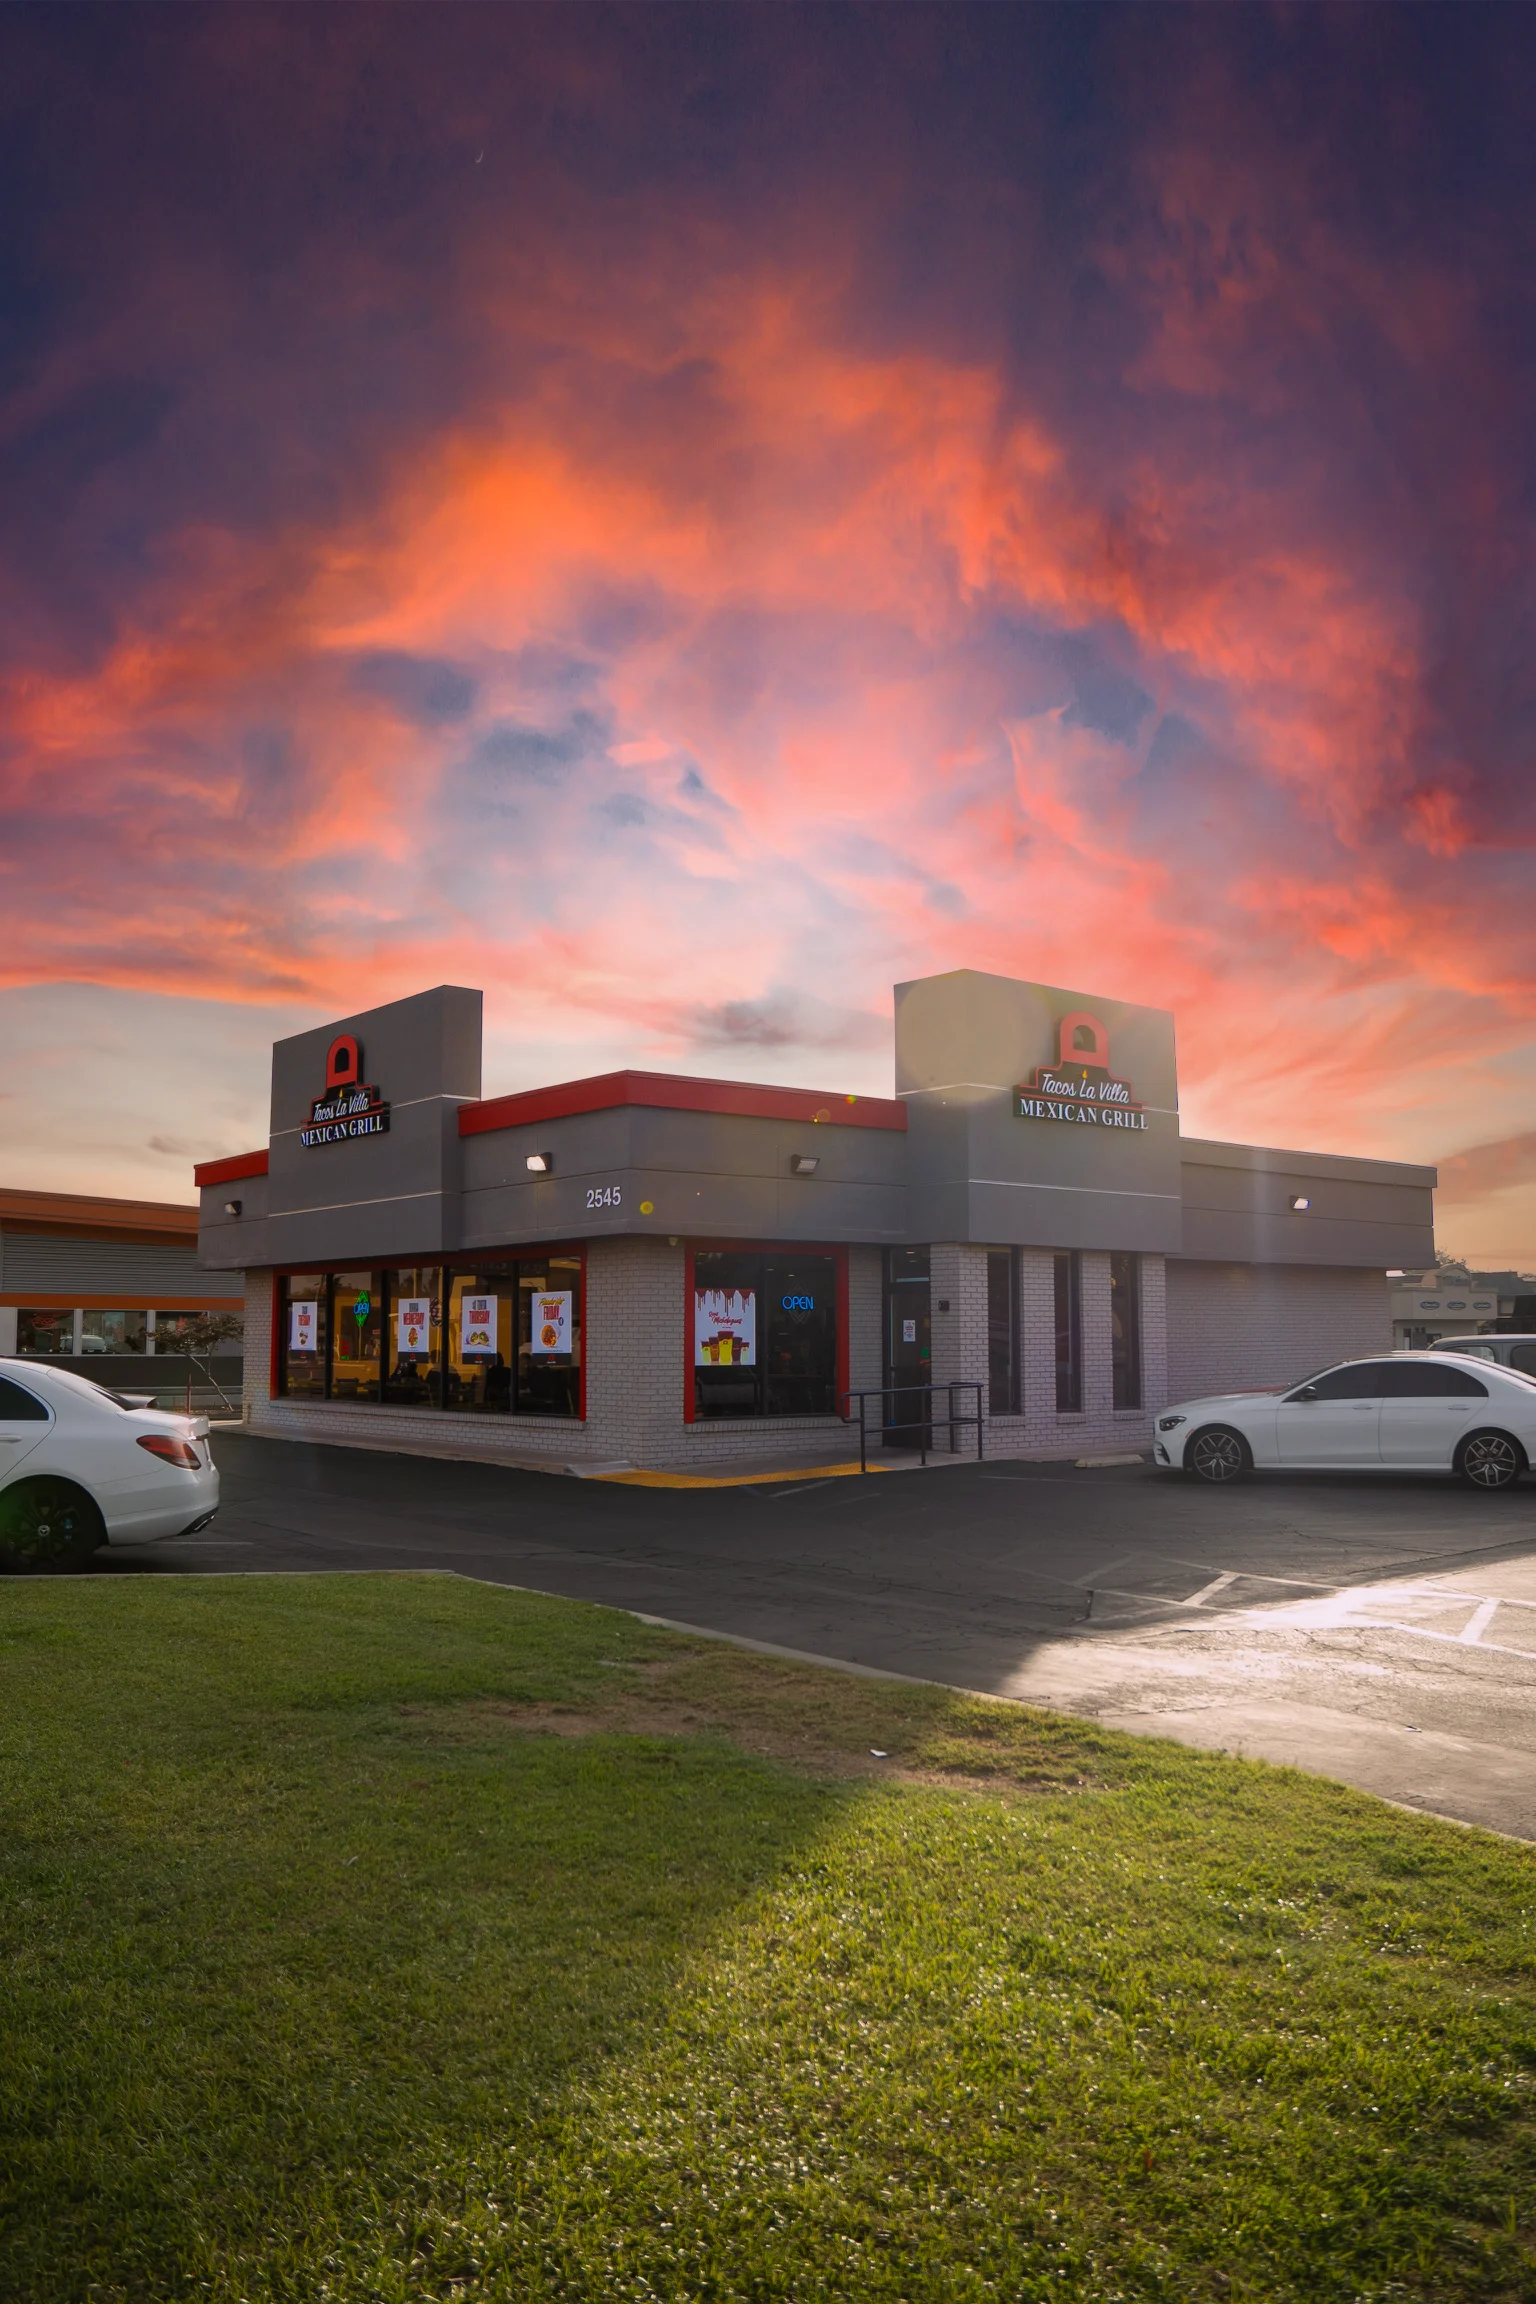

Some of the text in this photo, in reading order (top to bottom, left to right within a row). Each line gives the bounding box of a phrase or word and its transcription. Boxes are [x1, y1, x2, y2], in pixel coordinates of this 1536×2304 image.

[1042, 1073, 1130, 1104] Tacos La Villa
[313, 1092, 370, 1122] Tacos La Villa
[1020, 1099, 1149, 1130] MEXICAN GRILL
[300, 1115, 383, 1147] MEXICAN GRILL
[586, 1186, 621, 1208] 2545
[781, 1296, 814, 1310] OPEN
